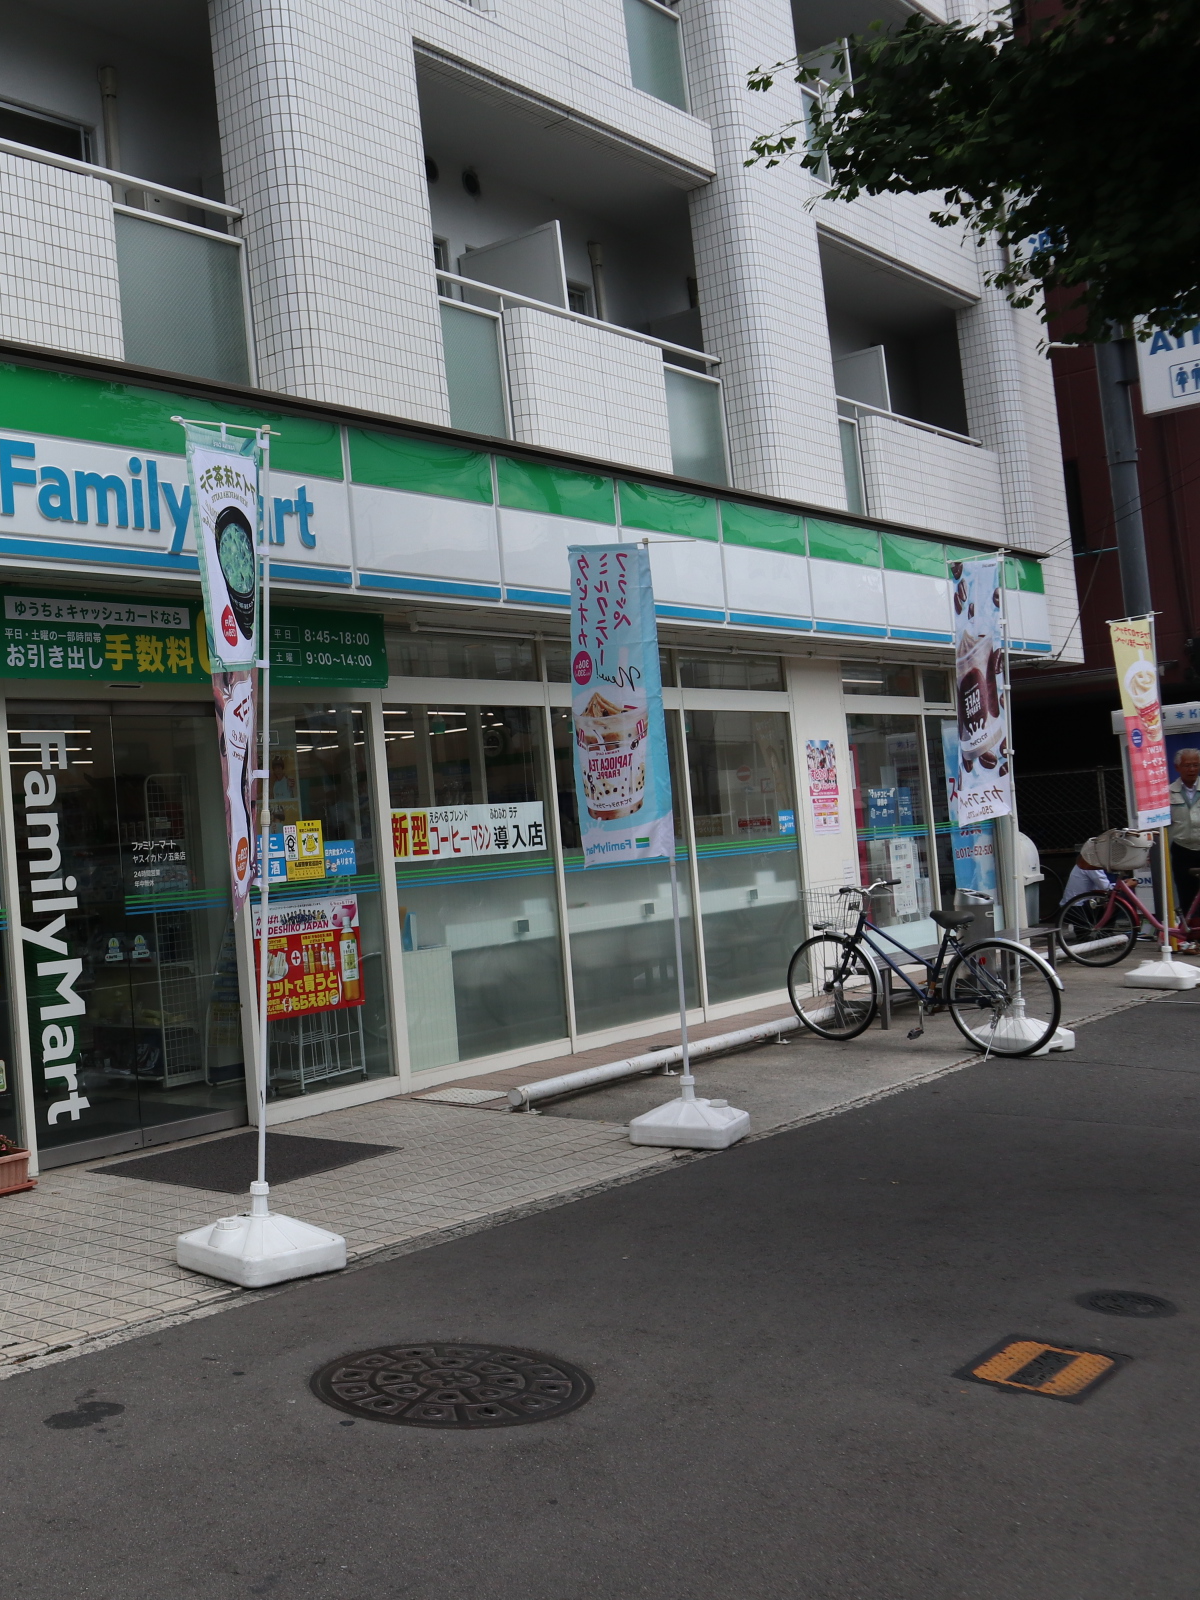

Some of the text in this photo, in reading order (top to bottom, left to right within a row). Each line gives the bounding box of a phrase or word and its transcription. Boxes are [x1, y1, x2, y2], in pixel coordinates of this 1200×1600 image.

[14, 602, 182, 626] ゆうちょキャッシュカードなら
[4, 628, 101, 644] 平日・土曜の一部時間帯
[273, 629, 291, 639] 平日
[6, 644, 102, 670] お引き出し
[274, 652, 294, 663] 土曜
[131, 840, 176, 851] ファミリーマート
[20, 732, 92, 1126] FamilyMart
[255, 914, 280, 927] がばれ
[255, 923, 301, 937] NDESHIKO
[302, 919, 329, 931] JAPAN
[291, 990, 329, 1011] もらえる!
